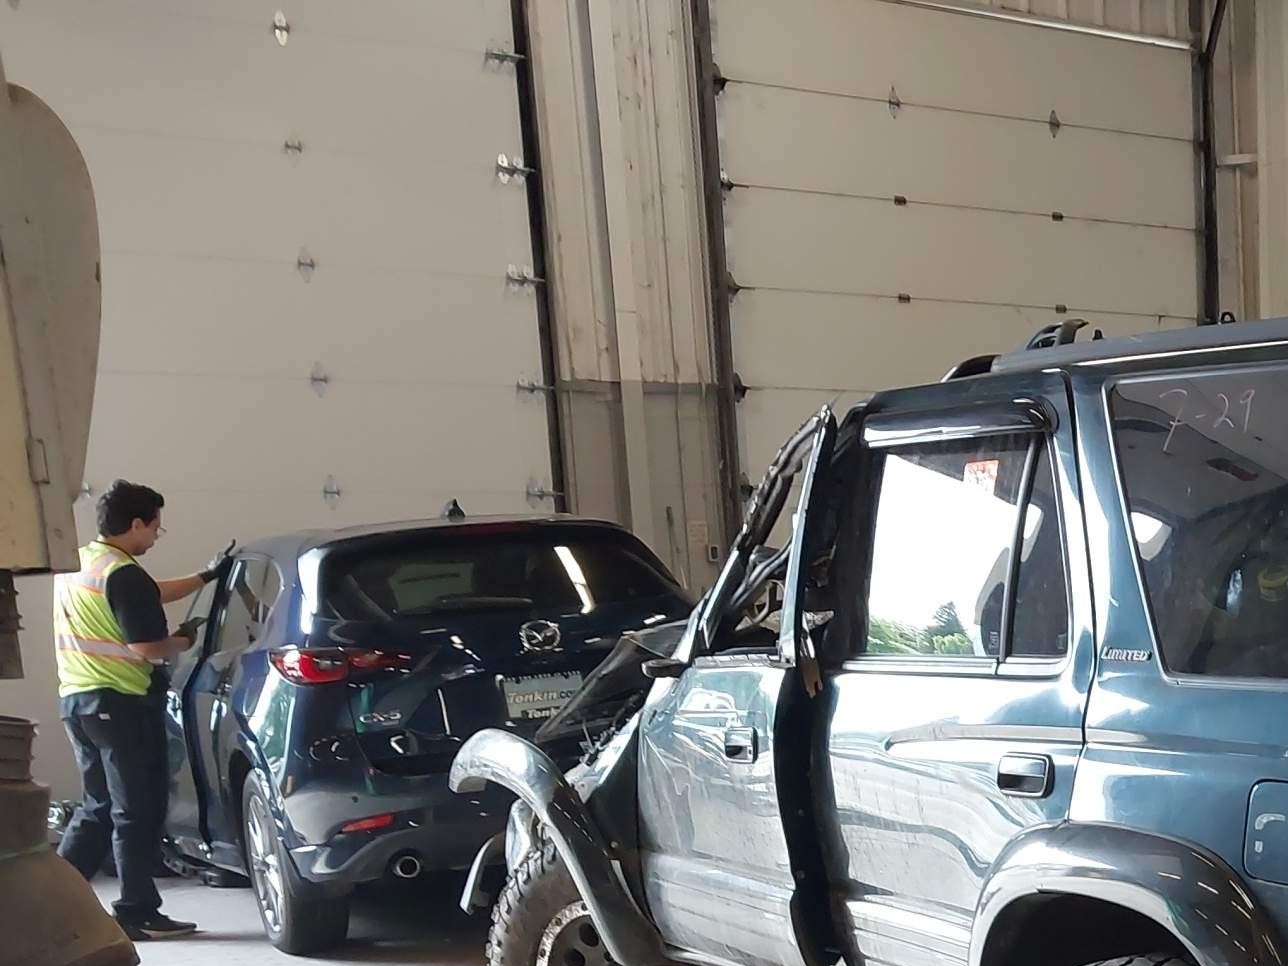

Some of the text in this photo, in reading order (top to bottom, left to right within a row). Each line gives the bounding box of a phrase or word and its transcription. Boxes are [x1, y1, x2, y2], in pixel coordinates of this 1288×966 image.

[1160, 388, 1256, 452] 7-29
[508, 690, 577, 704] Tonkin.co
[527, 707, 560, 719] Tonk
